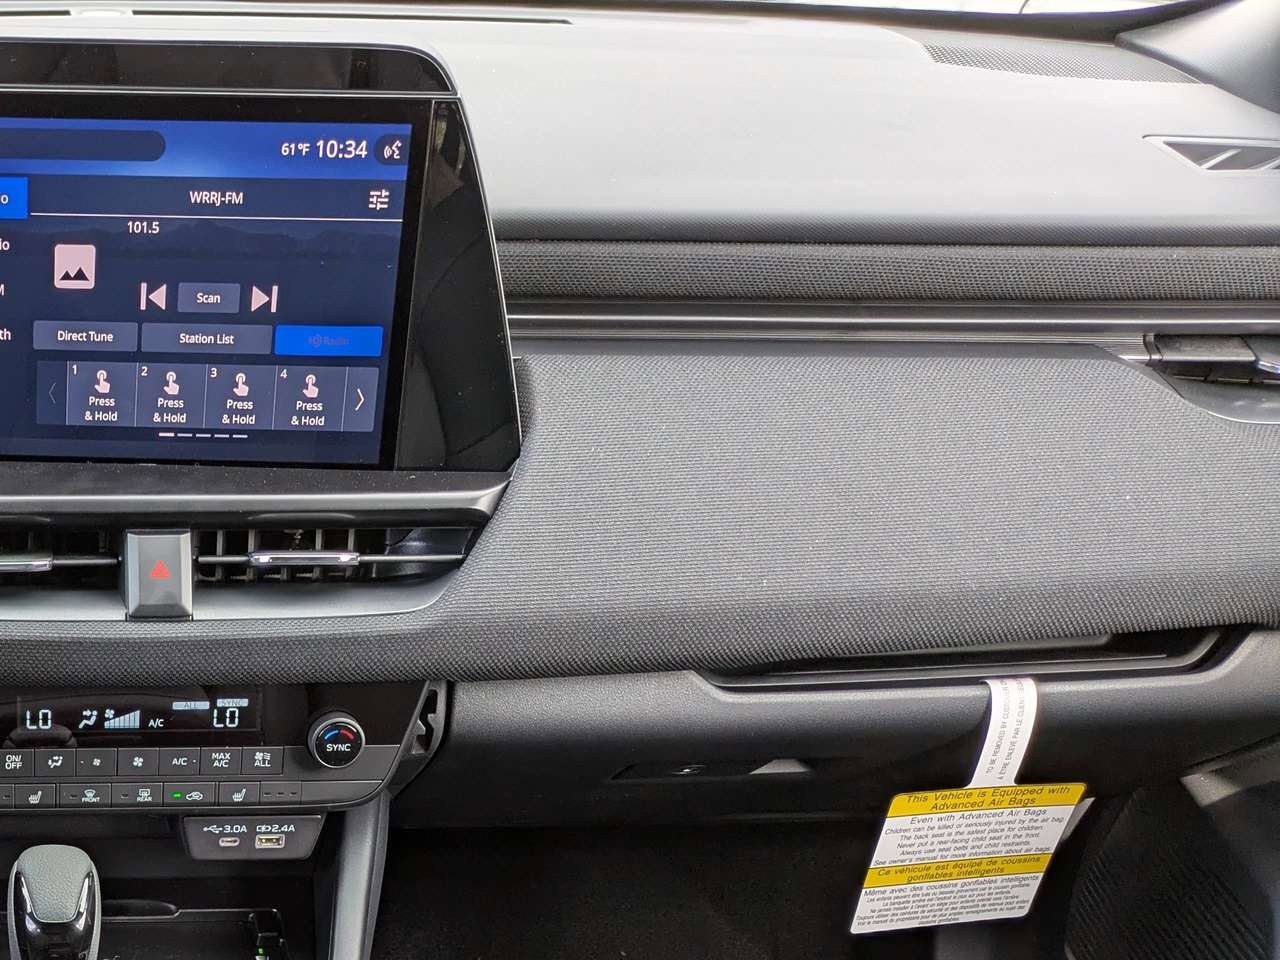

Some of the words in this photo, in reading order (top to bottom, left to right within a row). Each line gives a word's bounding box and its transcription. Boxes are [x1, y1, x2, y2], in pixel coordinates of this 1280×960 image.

[316, 140, 368, 159] 10:34
[189, 191, 244, 206] WRRJ-FM
[127, 222, 160, 234] 101.5
[196, 293, 221, 304] Scan
[57, 331, 87, 342] Direct
[89, 331, 114, 342] Tune
[180, 333, 214, 345] Station
[217, 333, 234, 344] List
[72, 364, 77, 375] 1
[141, 366, 148, 376] 2
[211, 368, 217, 378] 3
[280, 369, 288, 379] 4
[88, 396, 115, 407] Press
[157, 397, 184, 408] Press
[227, 399, 253, 410] Press
[297, 401, 323, 411] Press
[84, 411, 93, 421] &
[95, 410, 118, 421] Hold
[153, 413, 162, 422] &
[163, 412, 187, 423] Hold
[222, 415, 230, 424] &
[232, 414, 255, 425] Hold
[291, 416, 299, 425] &
[301, 415, 325, 426] Hold
[149, 719, 164, 728] A/C
[326, 743, 351, 752] SYNC
[212, 752, 231, 760] MAX
[5, 762, 22, 770] OFF
[172, 758, 187, 766] A/C
[213, 760, 229, 768] A/C
[255, 759, 271, 767] ALL
[907, 794, 928, 802] This
[933, 791, 973, 800] Vehicle
[991, 786, 1043, 797] Equipped
[930, 799, 984, 810] Advanced
[989, 798, 1003, 806] Air
[1008, 796, 1036, 805] Bags
[911, 816, 933, 824] Even
[959, 811, 1003, 820] Advanced
[1023, 807, 1046, 817] Bags
[223, 825, 247, 833] 3.0A
[272, 824, 296, 833] 2.4A
